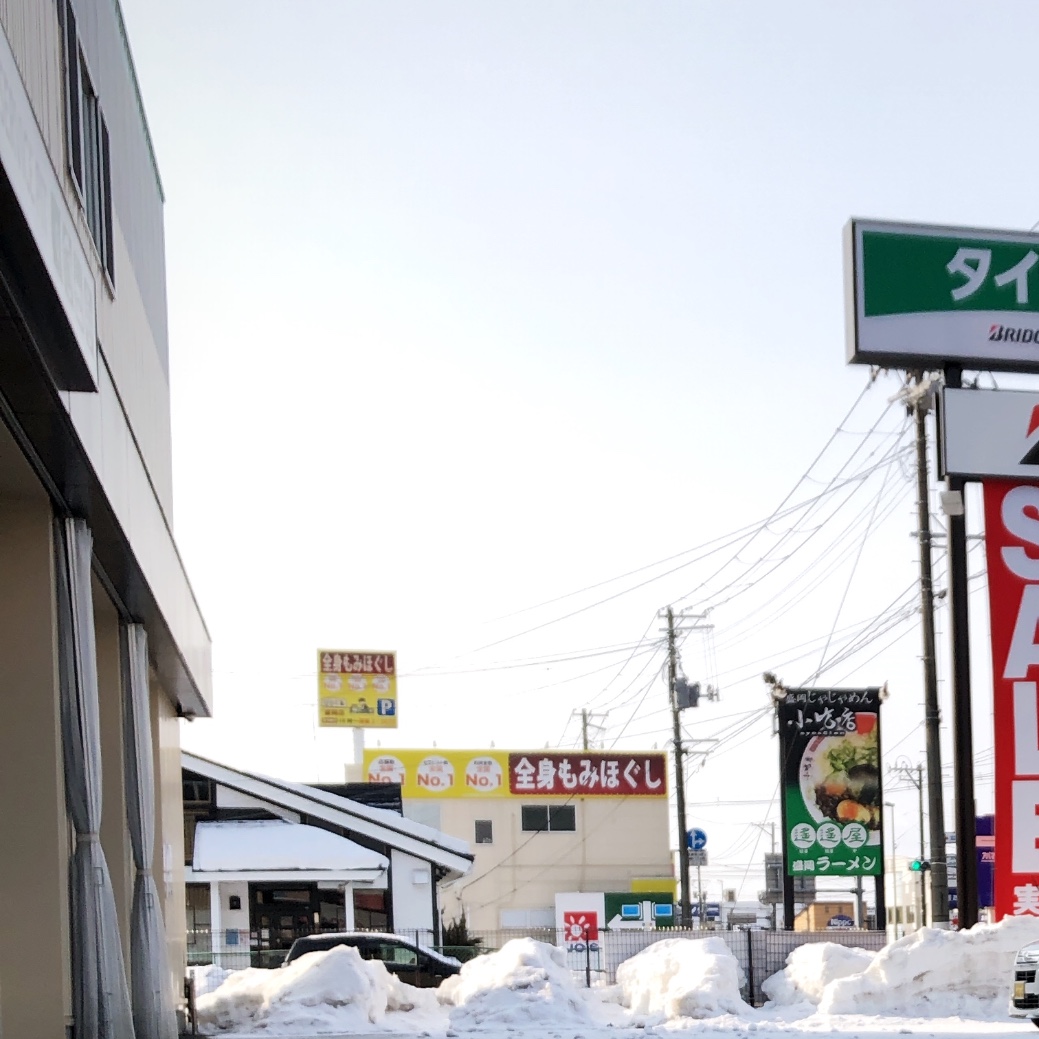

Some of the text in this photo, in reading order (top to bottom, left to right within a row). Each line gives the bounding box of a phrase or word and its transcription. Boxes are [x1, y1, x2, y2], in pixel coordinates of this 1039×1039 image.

[322, 652, 393, 673] 全身もみほぐし
[368, 772, 405, 786] No1
[417, 773, 454, 787] No.1
[466, 773, 502, 787] No.1
[514, 757, 662, 790] 全身もみほぐし
